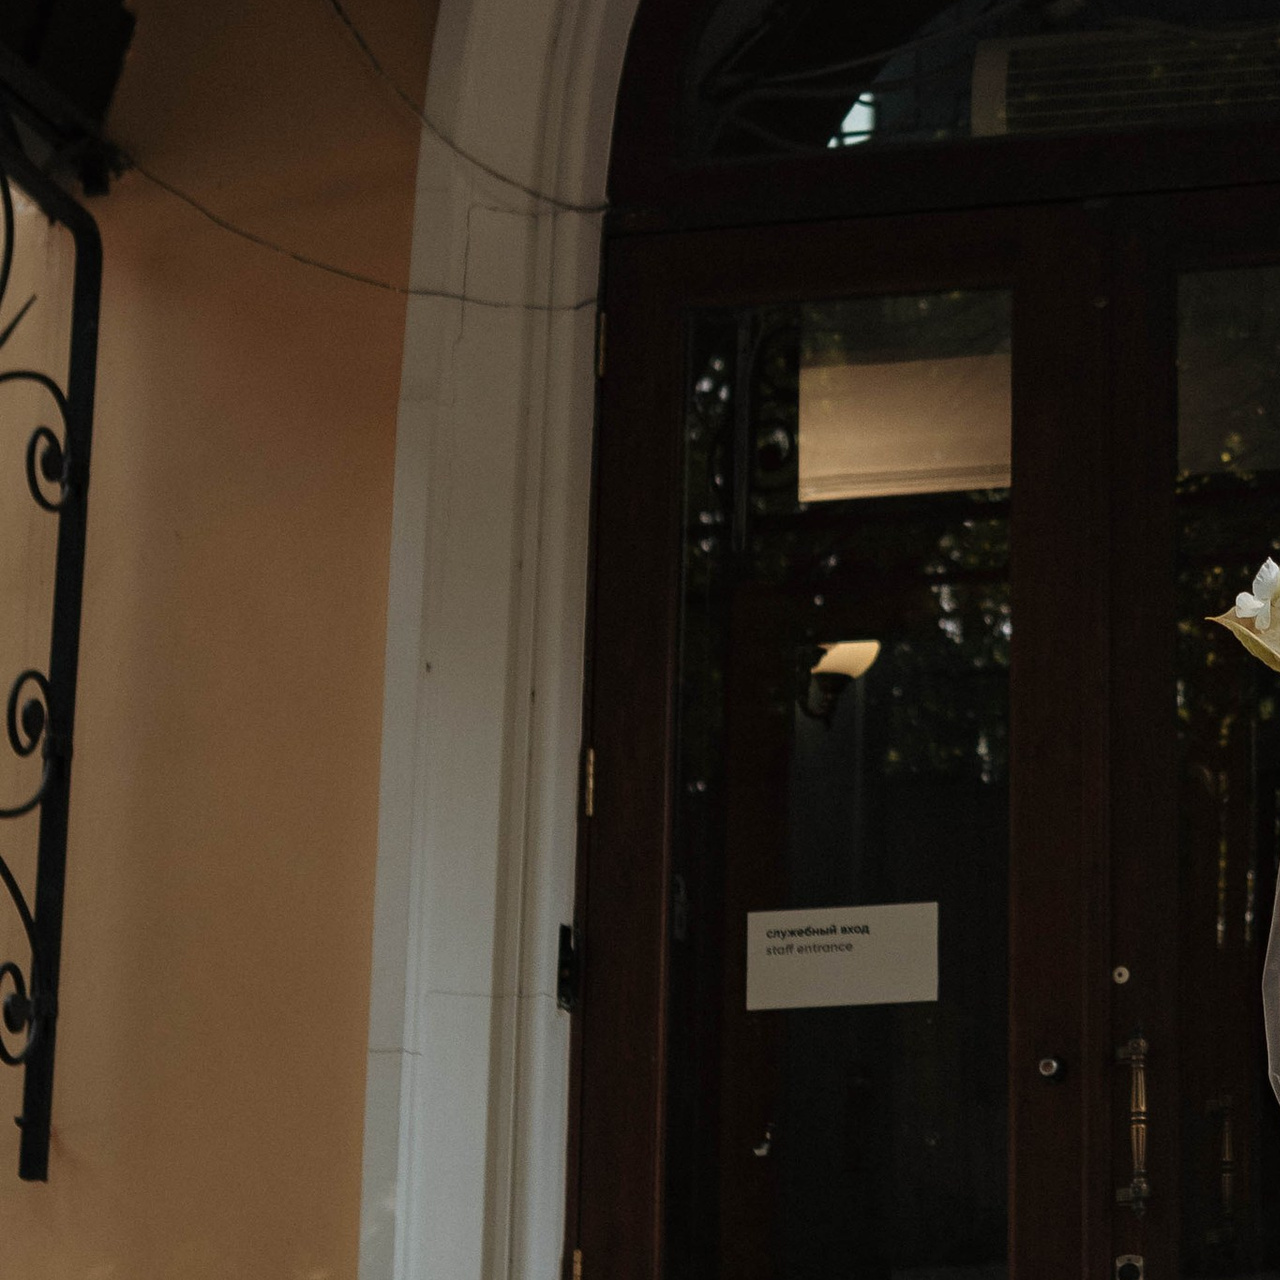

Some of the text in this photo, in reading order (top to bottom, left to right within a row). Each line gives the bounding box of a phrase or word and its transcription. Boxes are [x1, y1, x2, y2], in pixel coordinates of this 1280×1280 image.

[766, 924, 870, 940] служебный вход
[766, 942, 853, 956] staff entrance
